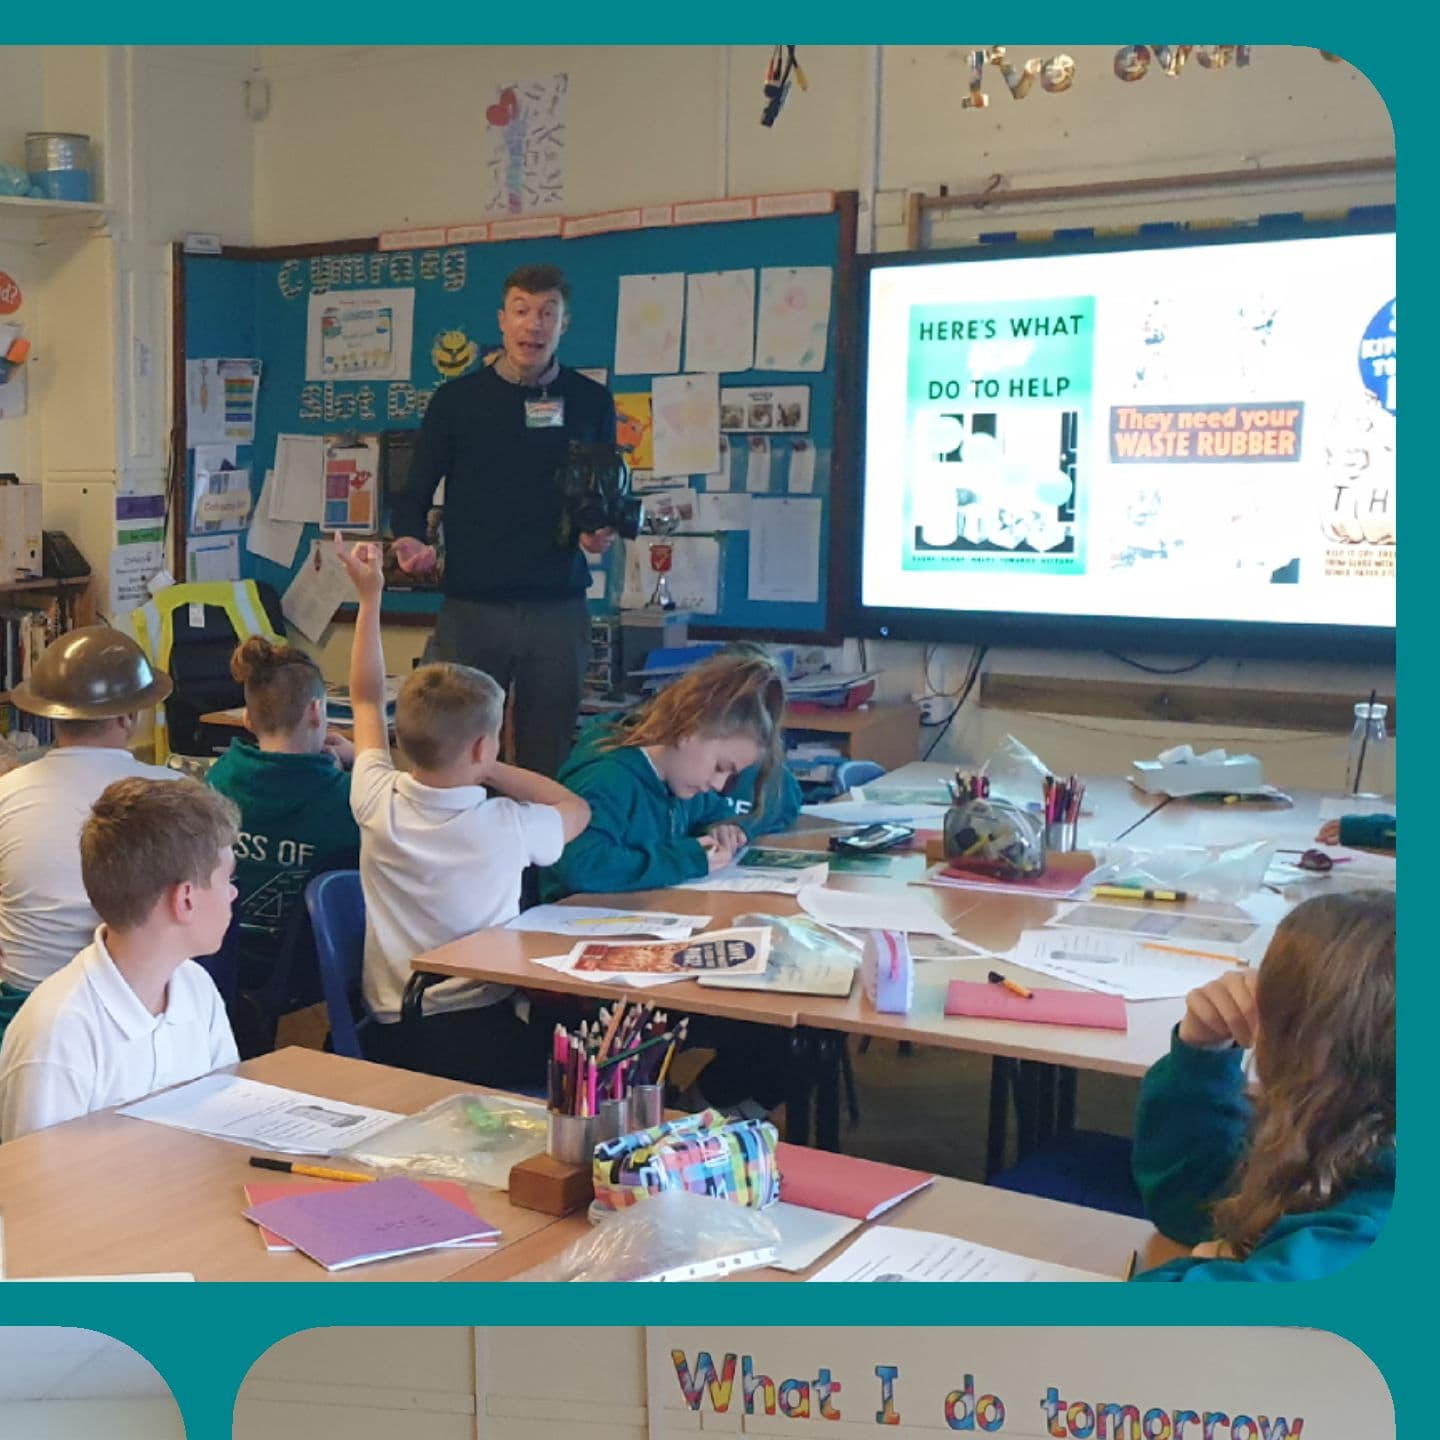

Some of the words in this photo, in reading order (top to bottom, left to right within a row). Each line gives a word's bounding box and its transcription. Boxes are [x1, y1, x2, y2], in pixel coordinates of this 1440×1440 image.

[278, 250, 466, 298] Cymraeg
[920, 320, 996, 340] HERE'S
[1010, 315, 1084, 337] WHAT
[300, 382, 376, 421] Slot
[929, 381, 960, 399] DO
[971, 379, 1000, 398] TO
[1010, 377, 1071, 397] HELP
[1117, 408, 1174, 432] They
[1178, 407, 1236, 429] need
[1240, 408, 1299, 430] your
[1115, 431, 1190, 457] WASTE
[1197, 430, 1297, 456] RUBBER
[278, 840, 316, 867] OF
[671, 1349, 841, 1421] What
[875, 1366, 900, 1425] I
[945, 1374, 1005, 1432] do
